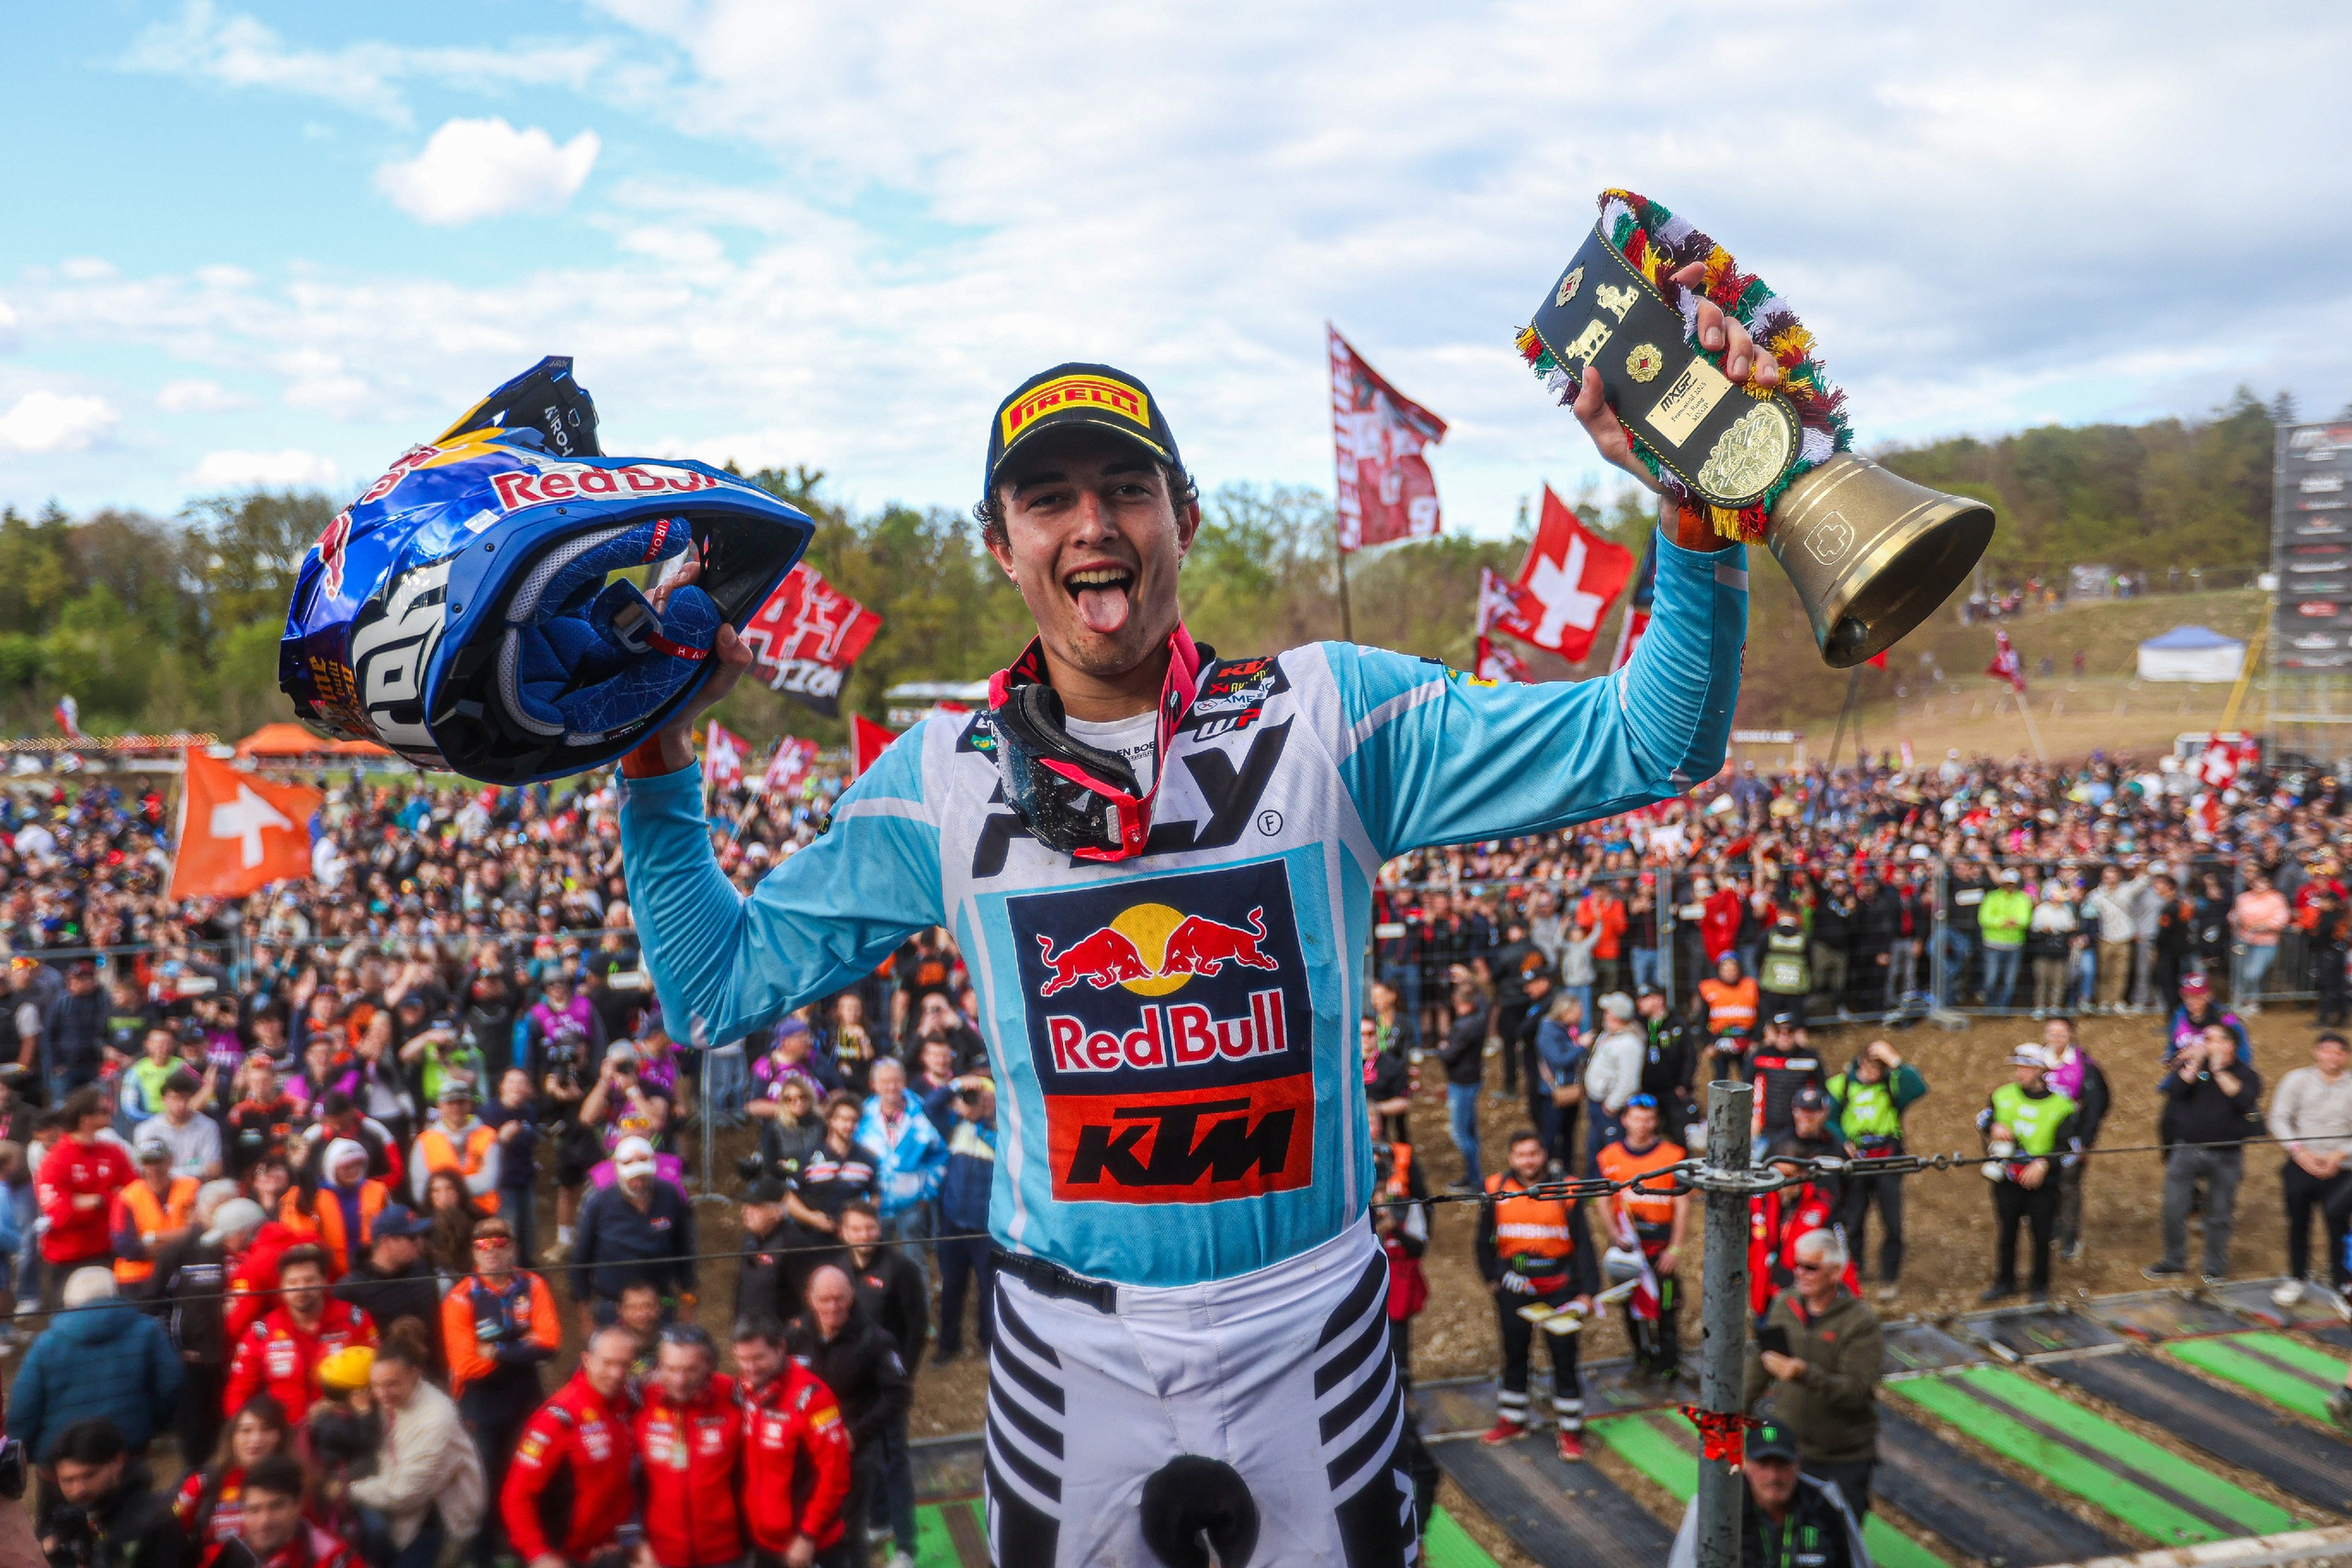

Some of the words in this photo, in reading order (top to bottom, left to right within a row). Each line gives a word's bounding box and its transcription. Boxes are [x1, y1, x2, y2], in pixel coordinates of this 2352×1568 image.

[1009, 379, 1139, 433] PIRELLI
[1660, 370, 1691, 412] MXGP
[492, 467, 619, 510] Red
[649, 517, 670, 557] AIROH
[1046, 1004, 1168, 1073] Red
[1167, 987, 1288, 1066] Bull
[1066, 1097, 1296, 1186] KTM
